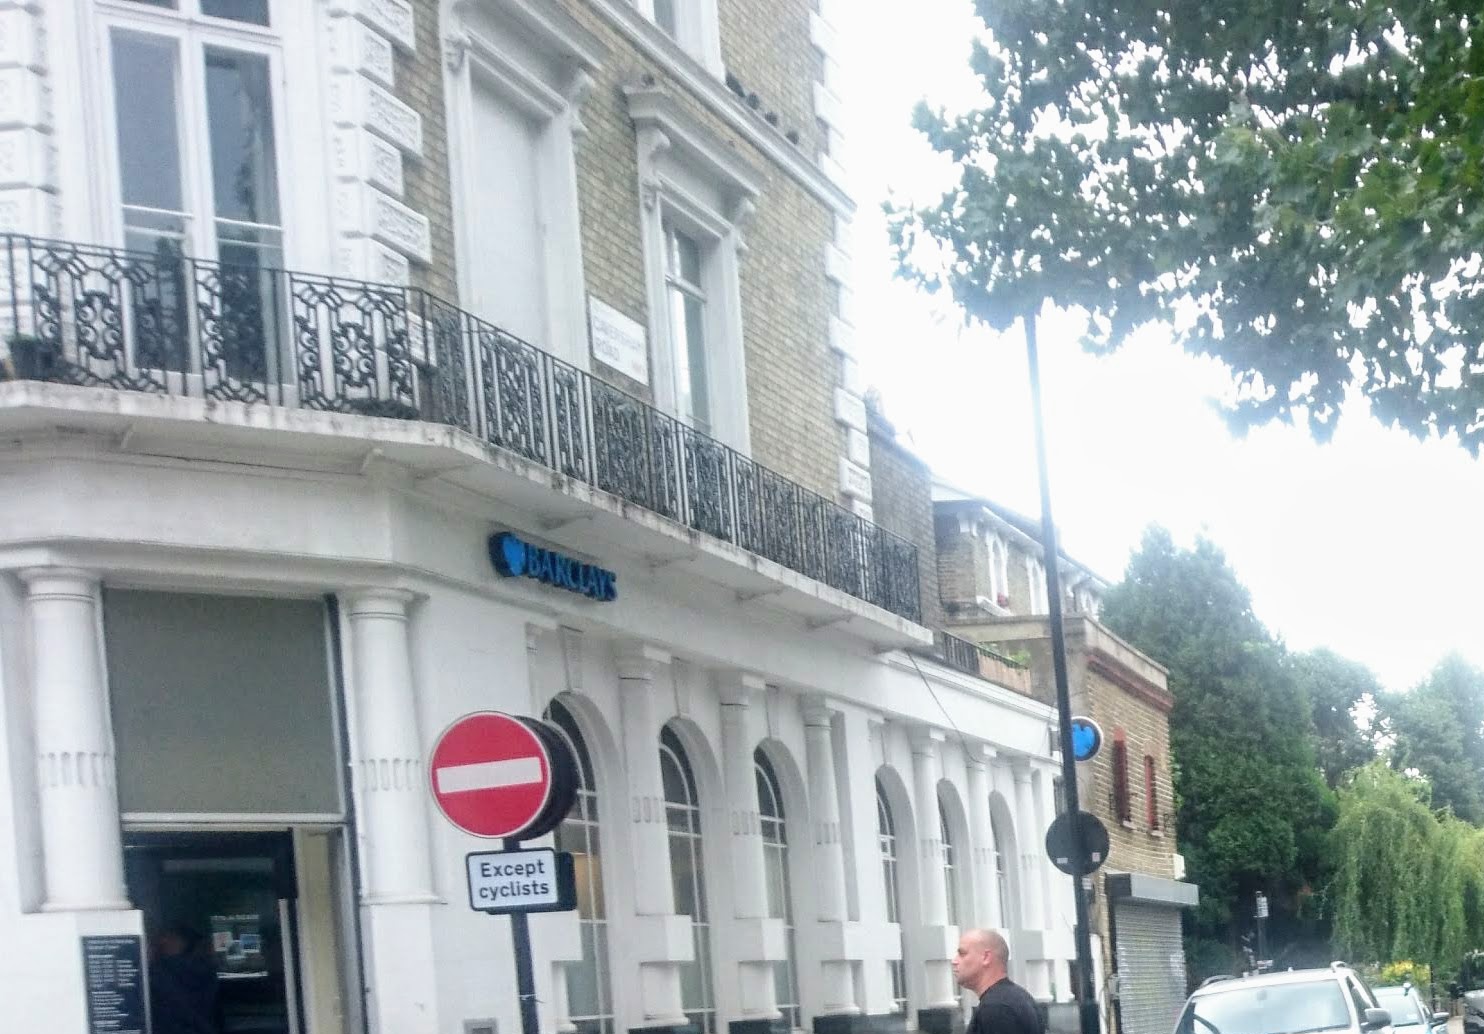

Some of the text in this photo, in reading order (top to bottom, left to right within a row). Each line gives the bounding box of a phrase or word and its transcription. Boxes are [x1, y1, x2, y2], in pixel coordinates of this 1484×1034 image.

[527, 543, 617, 601] BARCLAYS
[480, 859, 545, 878] Except
[479, 880, 549, 901] cyclists
